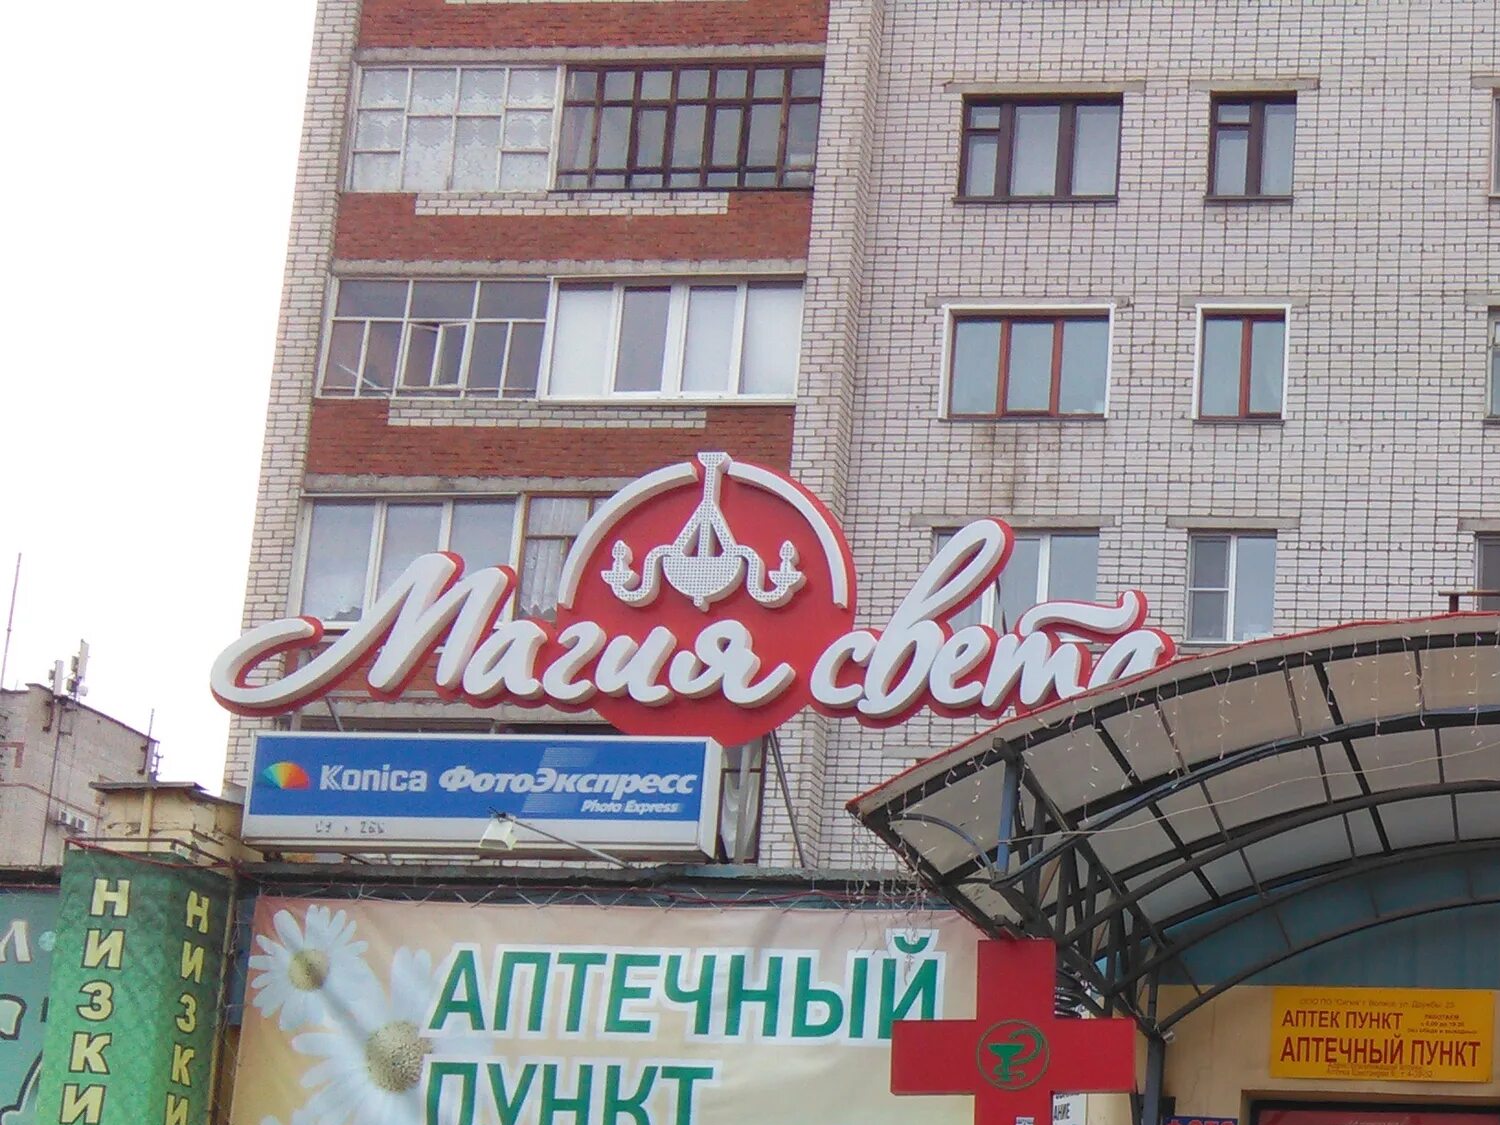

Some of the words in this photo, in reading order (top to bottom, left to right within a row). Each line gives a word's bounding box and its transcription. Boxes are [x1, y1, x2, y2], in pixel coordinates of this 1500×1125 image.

[210, 550, 796, 716] Магия
[319, 763, 428, 793] Konica
[438, 764, 698, 800] ФотоЭкспресс
[580, 798, 623, 814] Photo
[624, 800, 679, 813] Express
[428, 935, 939, 1041] АПТЕЧНЫЙ
[1281, 1009, 1341, 1028] АПТЕК
[1345, 1011, 1404, 1030] ПУНКТ
[1280, 1033, 1404, 1065] АПТЕЧНЫЙ
[1410, 1041, 1481, 1067] ПУНКТ
